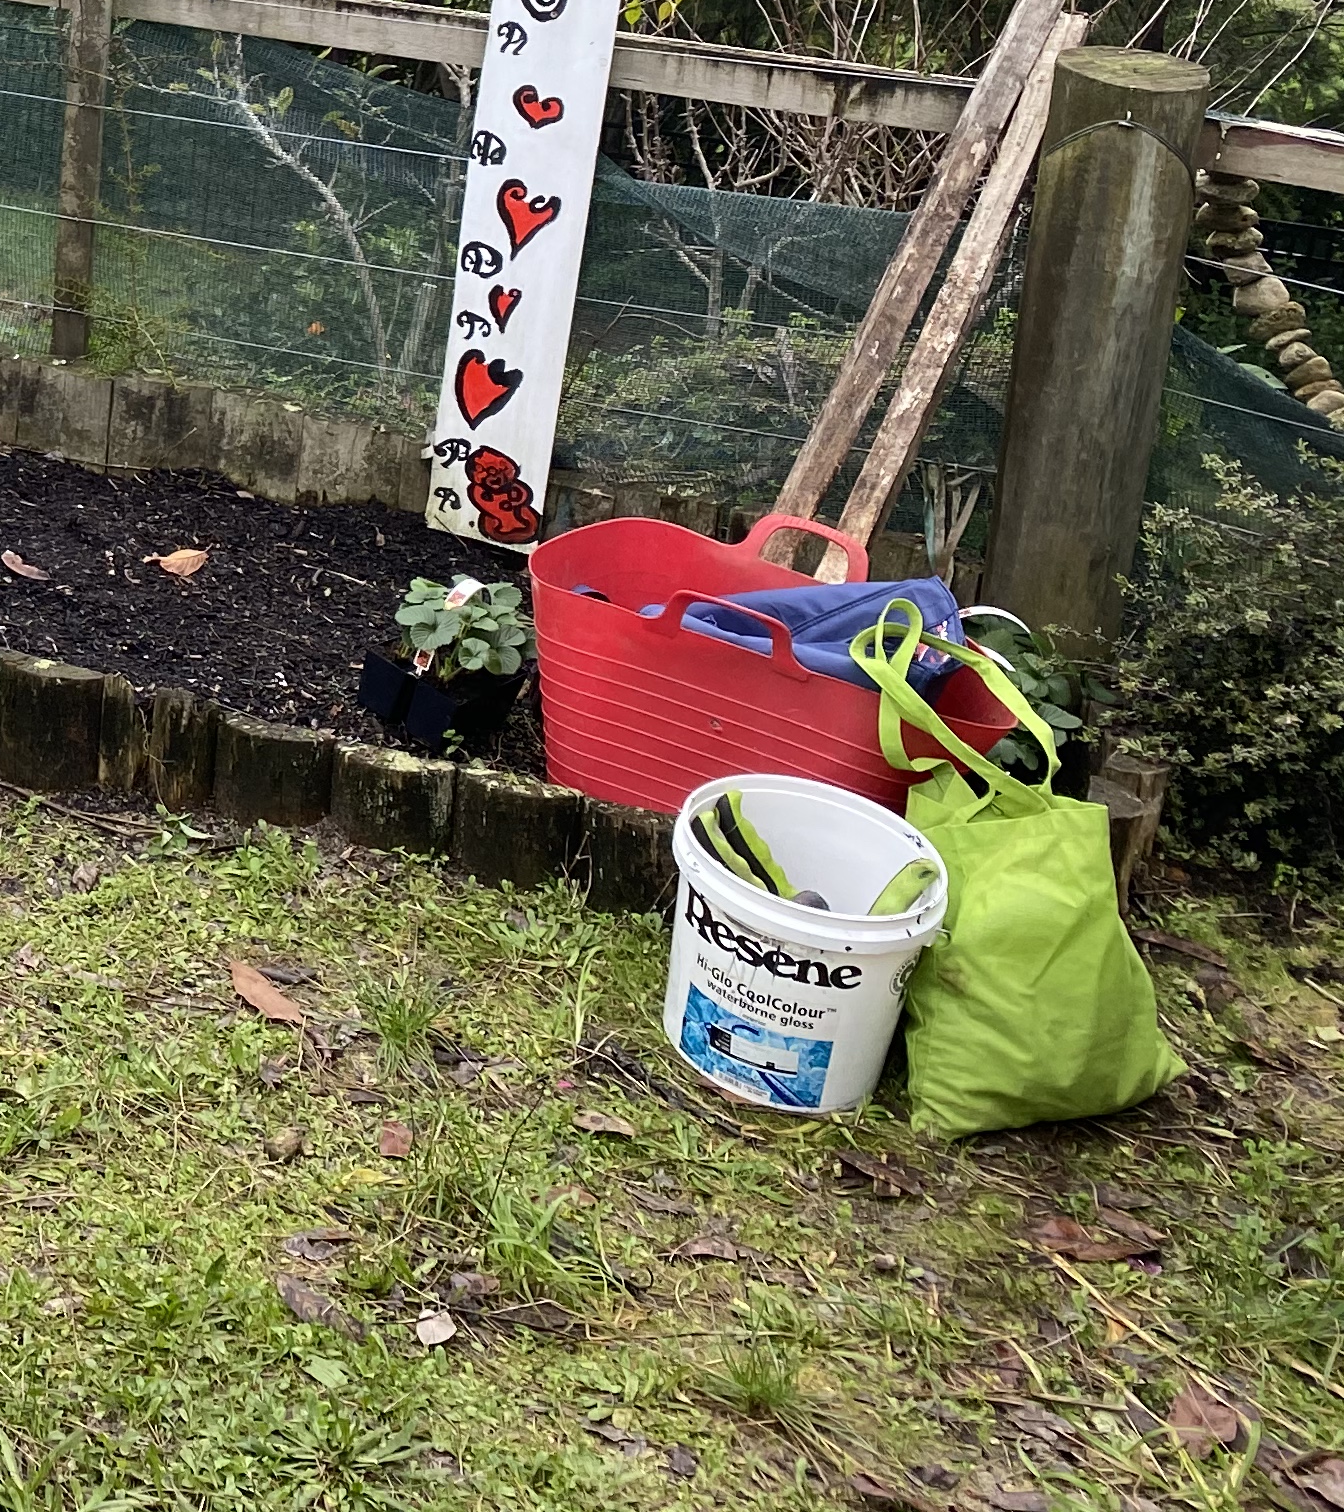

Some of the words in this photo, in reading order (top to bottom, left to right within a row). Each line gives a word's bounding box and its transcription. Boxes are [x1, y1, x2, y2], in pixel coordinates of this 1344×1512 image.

[685, 881, 862, 990] Resene
[697, 953, 733, 988] Hi-Glo
[707, 979, 777, 1021] waterborne
[780, 1016, 815, 1030] gloss
